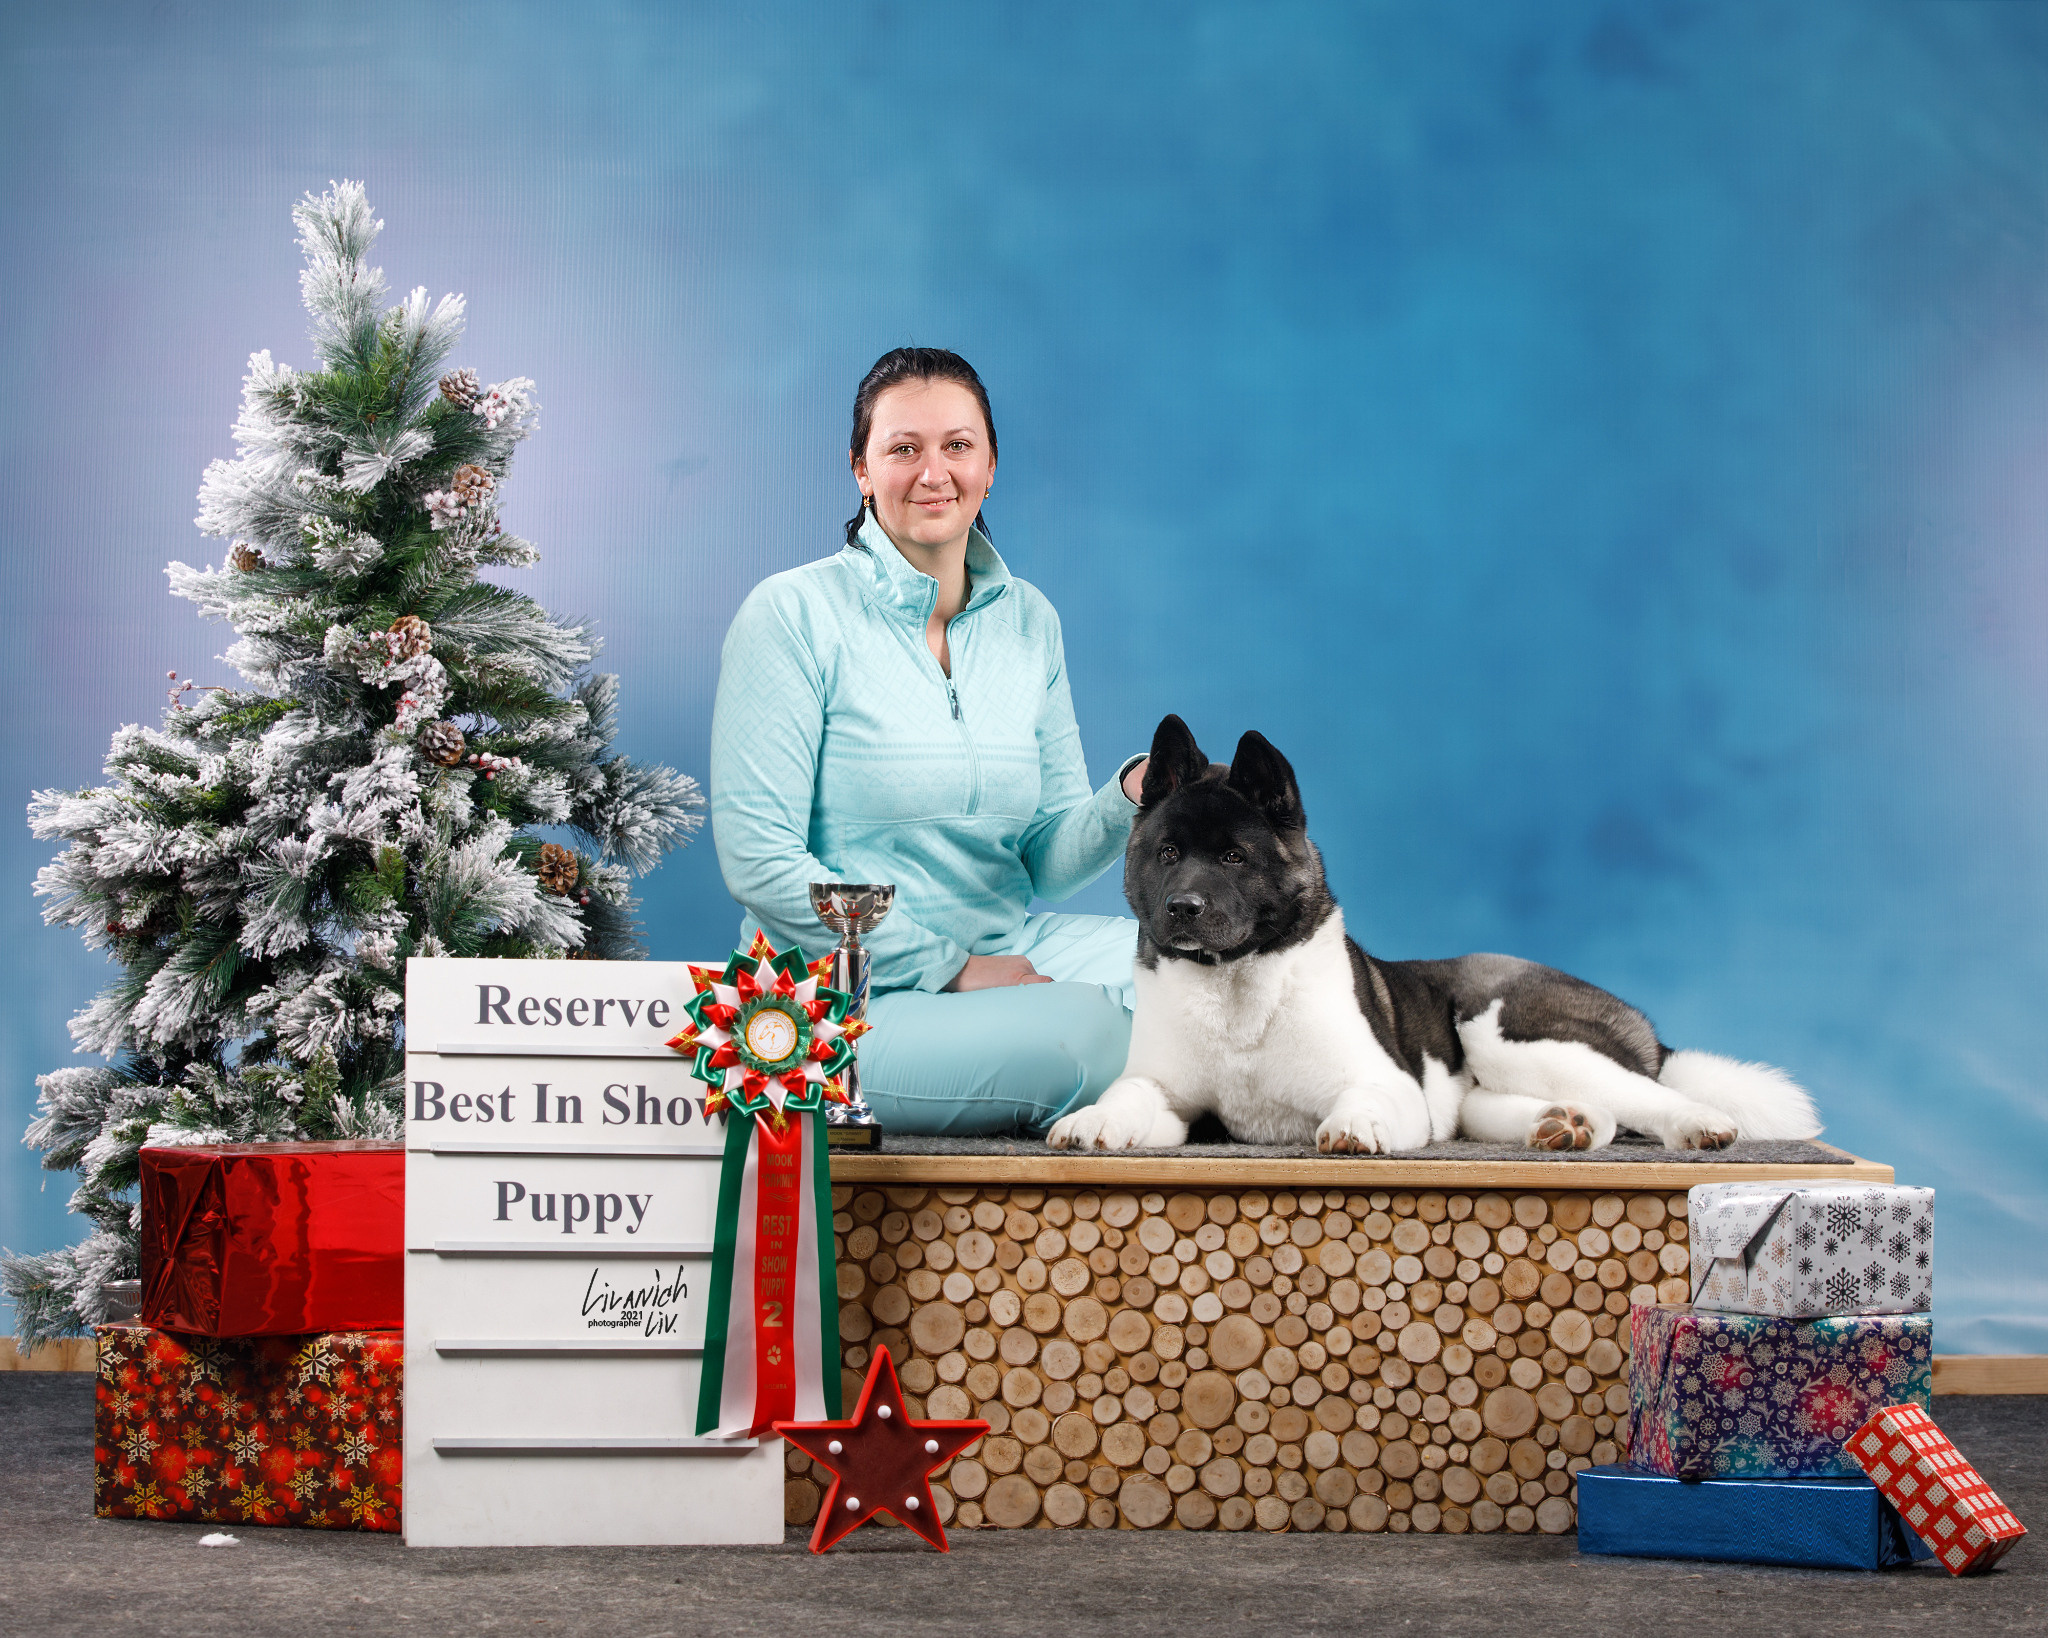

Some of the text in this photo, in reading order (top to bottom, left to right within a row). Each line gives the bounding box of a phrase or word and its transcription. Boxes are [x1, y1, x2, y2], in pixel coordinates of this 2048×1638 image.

[475, 984, 670, 1027] Reserve
[410, 1081, 516, 1122] Best
[532, 1083, 583, 1123] In
[493, 1181, 654, 1234] Puppy
[762, 1215, 793, 1236] BEST
[770, 1240, 783, 1250] IN
[761, 1255, 788, 1274] SHOW
[760, 1277, 786, 1297] PUPPY
[762, 1301, 784, 1328] 2
